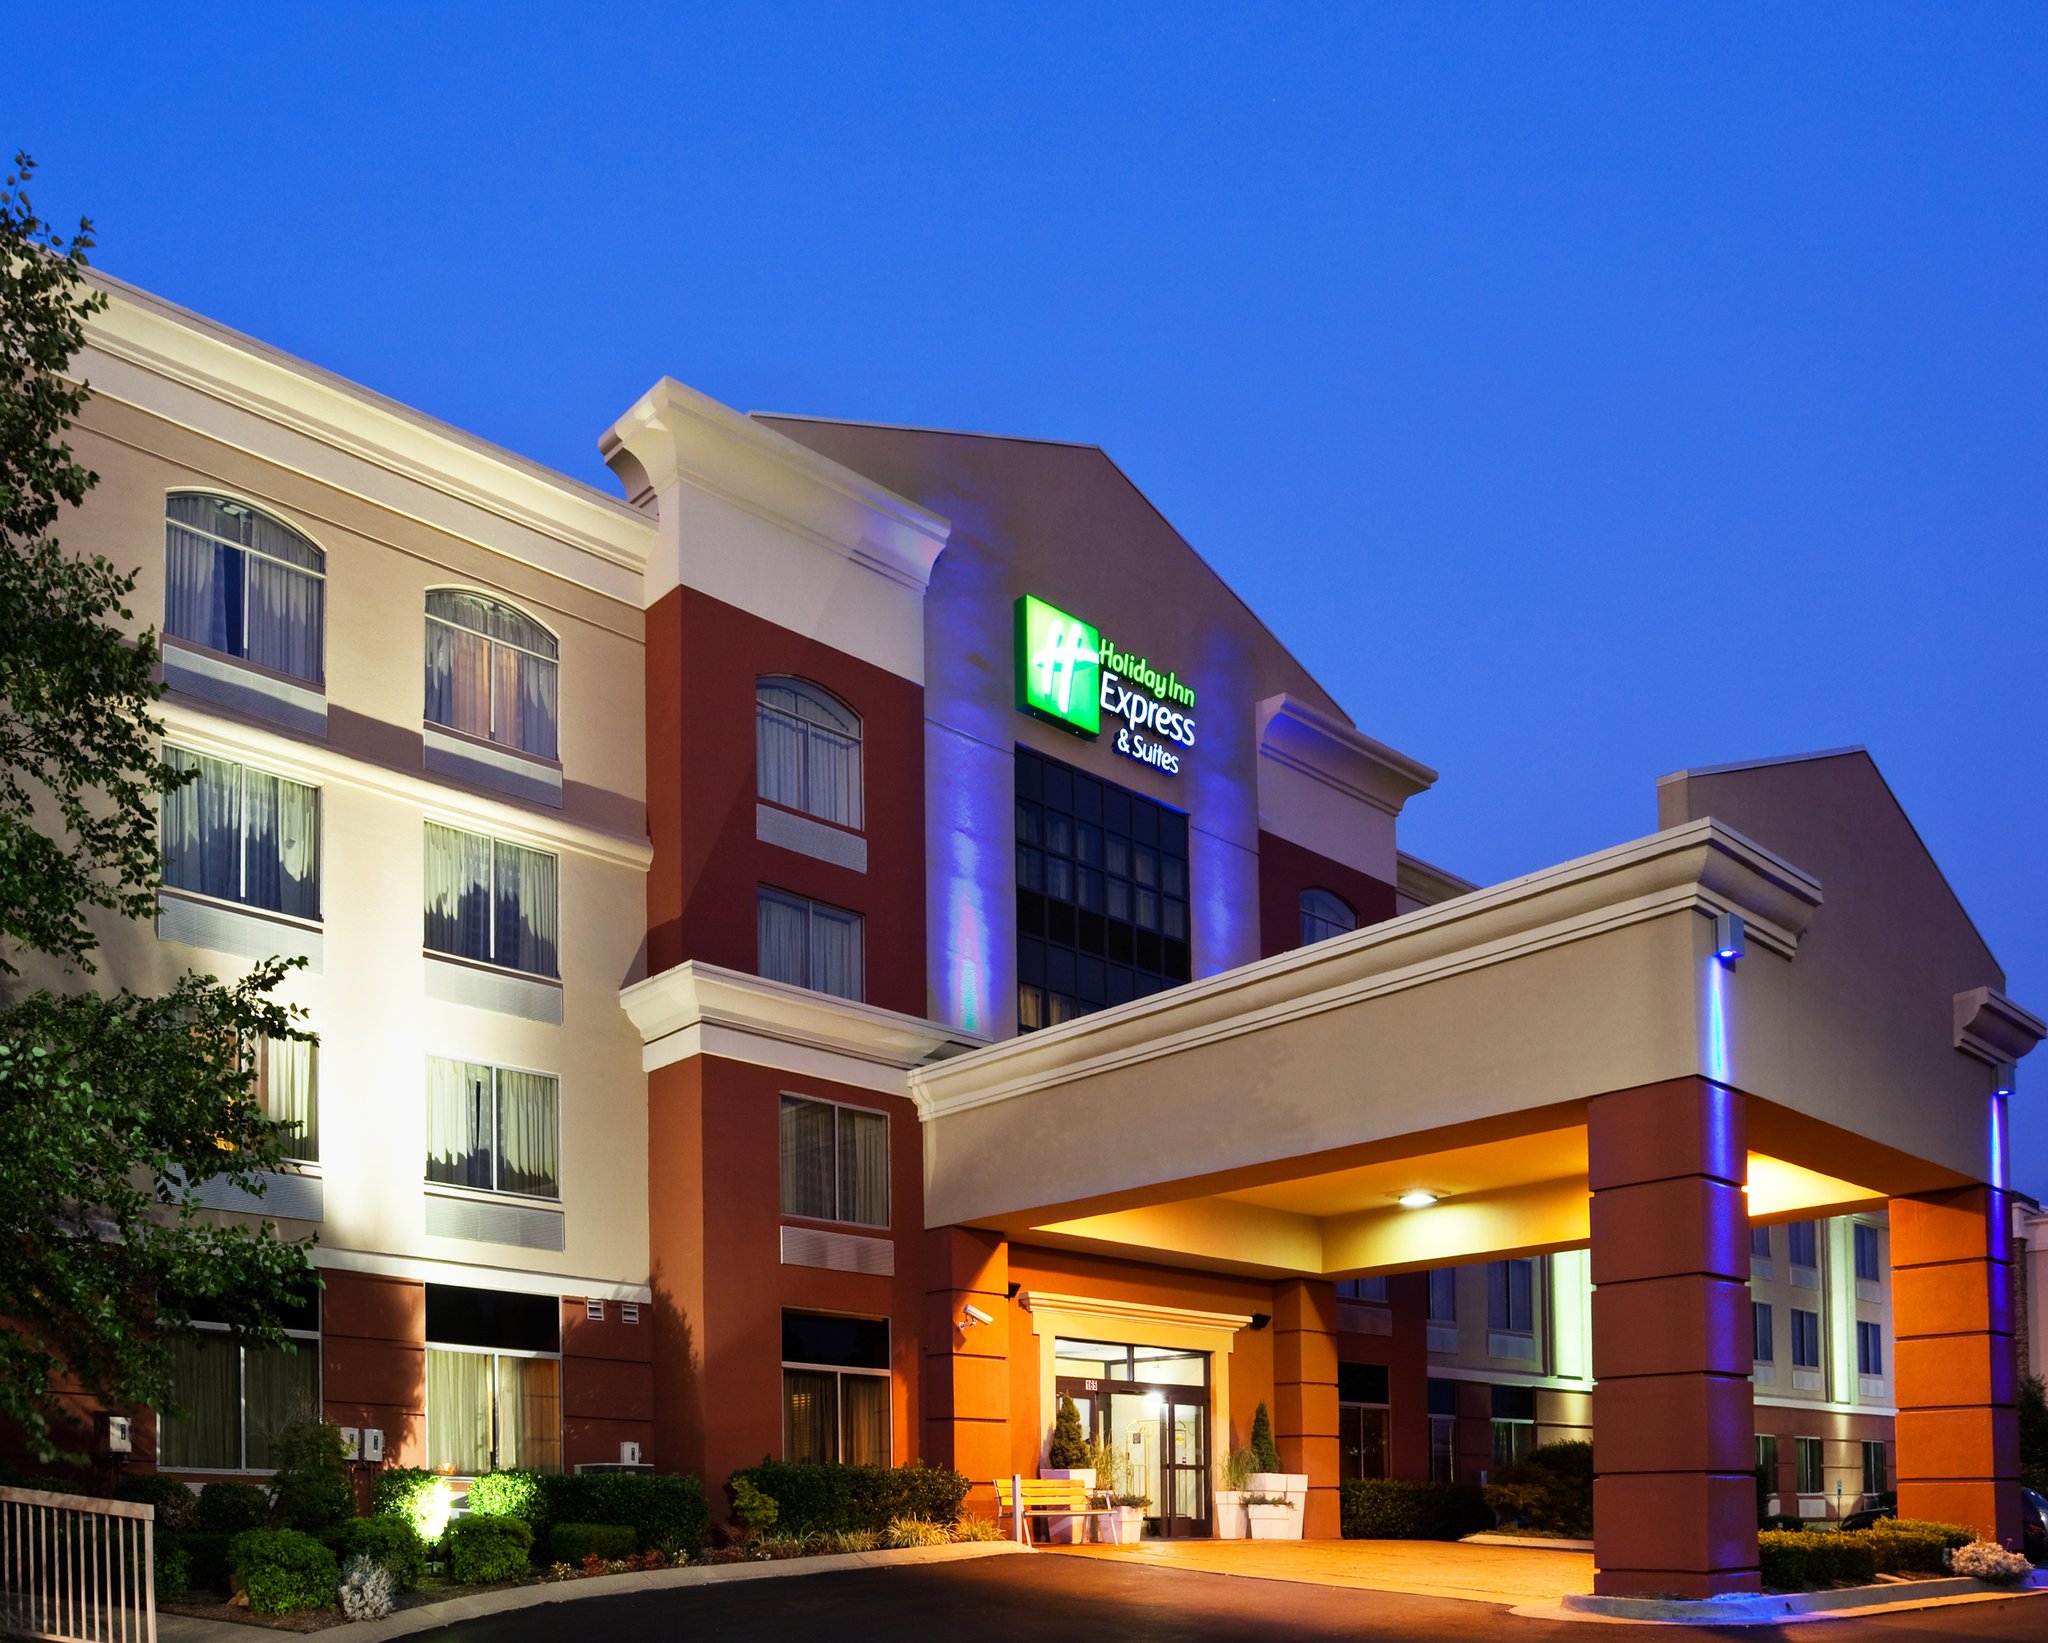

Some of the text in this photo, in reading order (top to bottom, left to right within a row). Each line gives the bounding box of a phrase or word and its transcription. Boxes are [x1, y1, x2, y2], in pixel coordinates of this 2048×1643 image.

[1099, 638, 1196, 709] Holiday Inn
[1100, 671, 1196, 747] Express
[1117, 728, 1180, 774] & Suites
